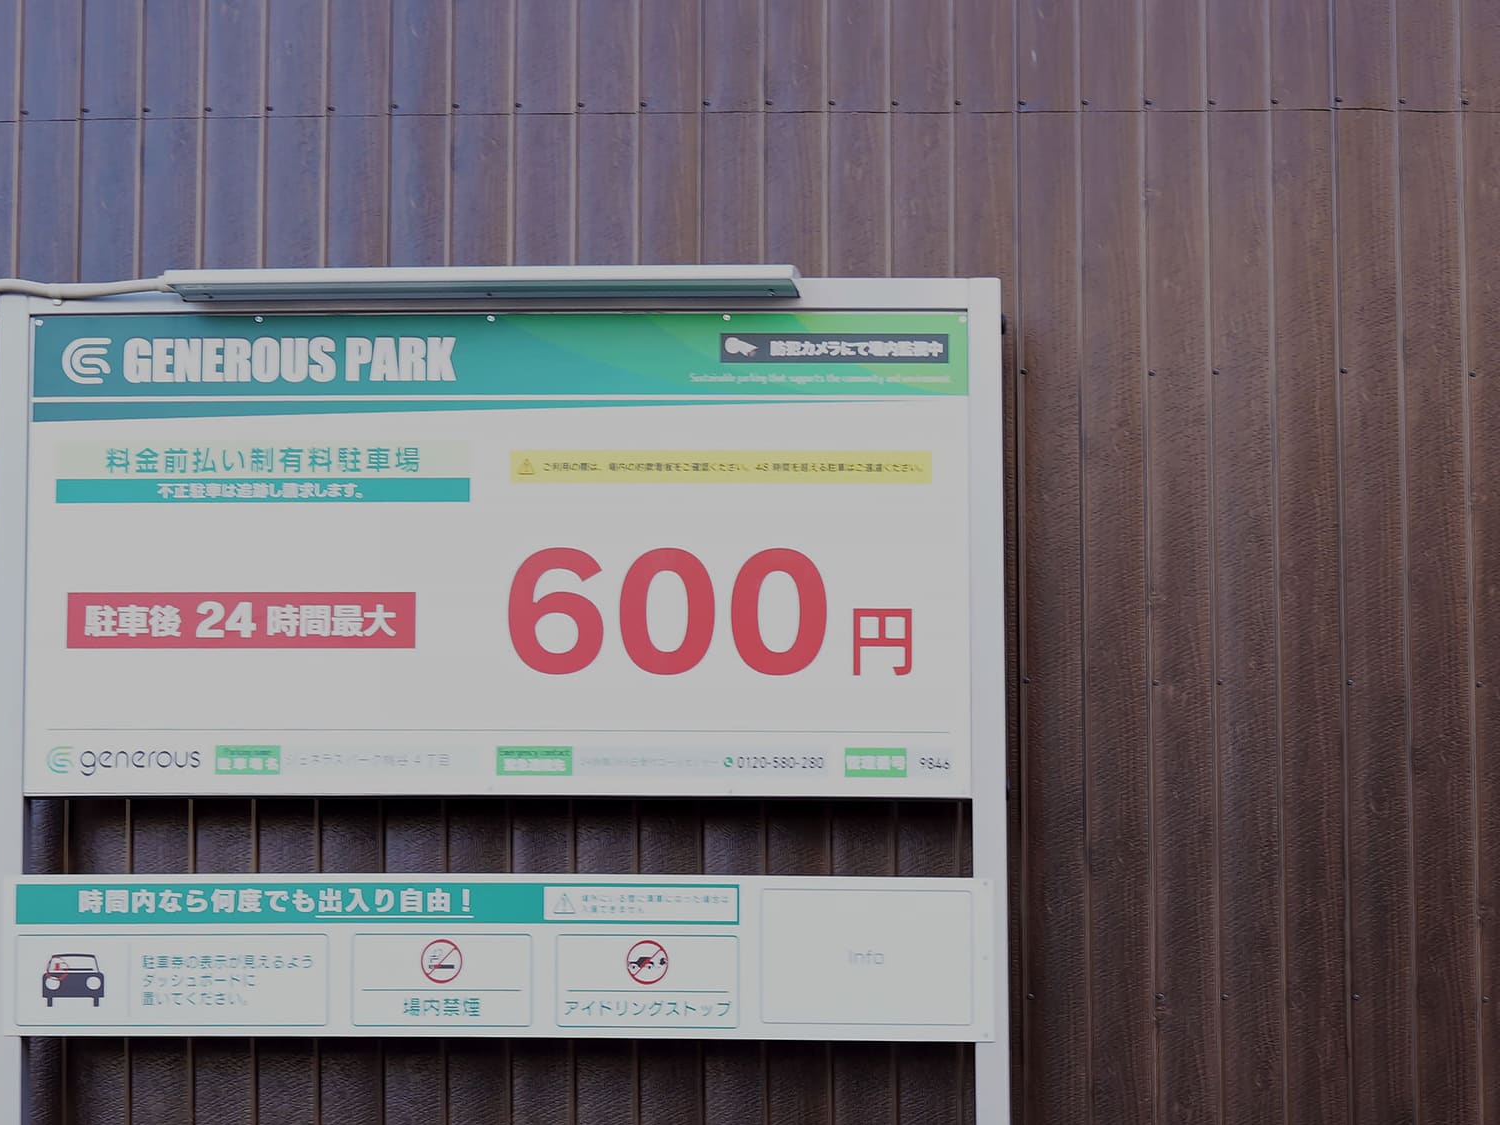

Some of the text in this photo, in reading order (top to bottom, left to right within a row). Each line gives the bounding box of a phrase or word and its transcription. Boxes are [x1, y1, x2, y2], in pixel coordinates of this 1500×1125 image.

[123, 336, 457, 384] GENEROUS PARK
[105, 447, 421, 474] 料金前払い制有料駐車場
[195, 600, 257, 638] 24
[79, 748, 201, 777] generous
[78, 889, 473, 914] 時間内なら何度でも出入り自由！
[848, 948, 885, 965] Info
[403, 997, 481, 1018] 場内禁煙
[563, 1000, 733, 1018] アイドリングストップ
